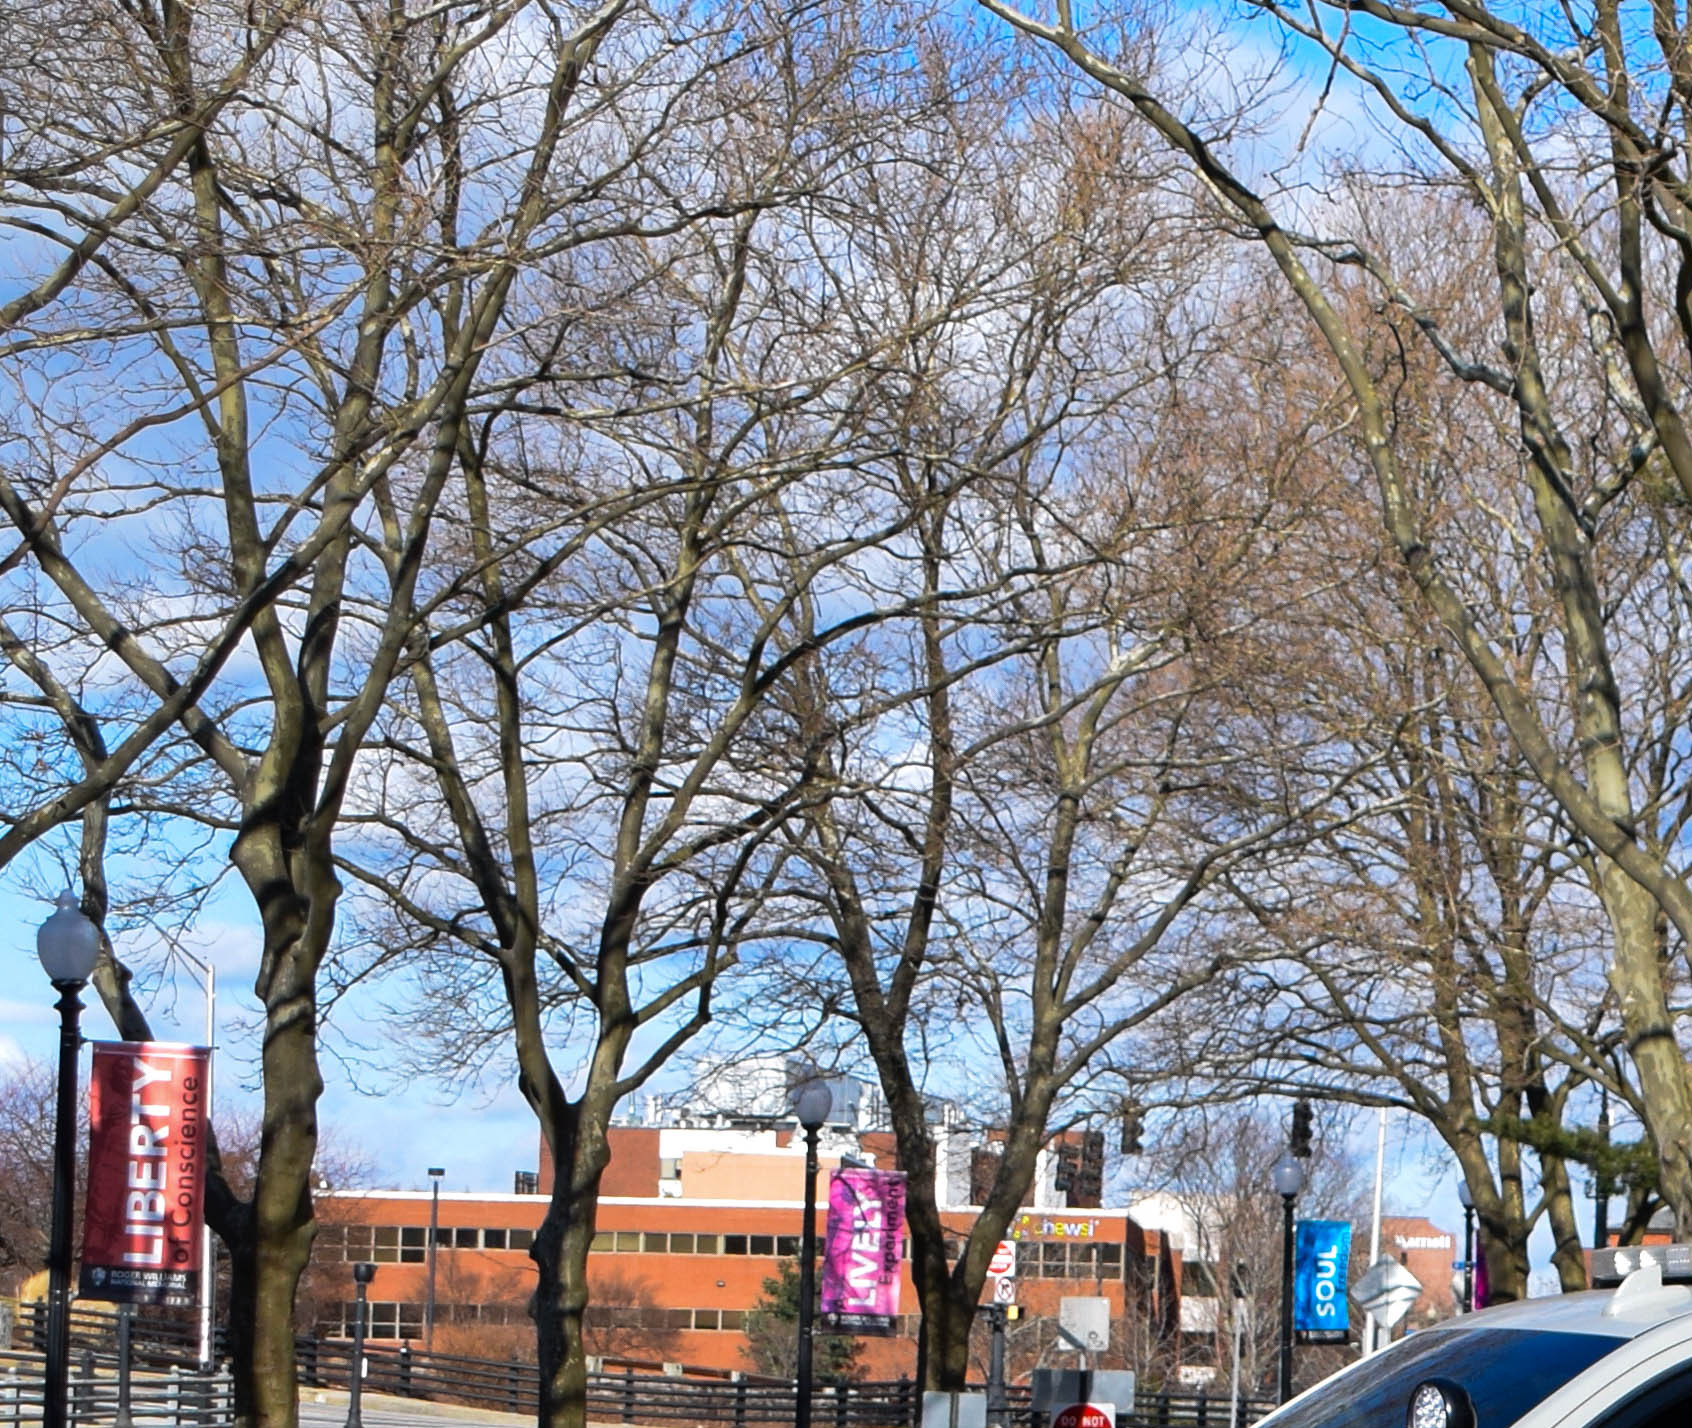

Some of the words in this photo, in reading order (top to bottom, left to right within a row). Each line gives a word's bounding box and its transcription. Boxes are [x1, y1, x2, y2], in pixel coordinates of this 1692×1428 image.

[123, 1057, 171, 1265] LIBERTY
[172, 1076, 199, 1227] Conscience
[168, 1237, 189, 1263] of
[847, 1190, 882, 1307] LIVELY
[1315, 1245, 1338, 1317] SOUL
[1061, 1415, 1077, 1427] DO
[1082, 1415, 1105, 1428] NOT
